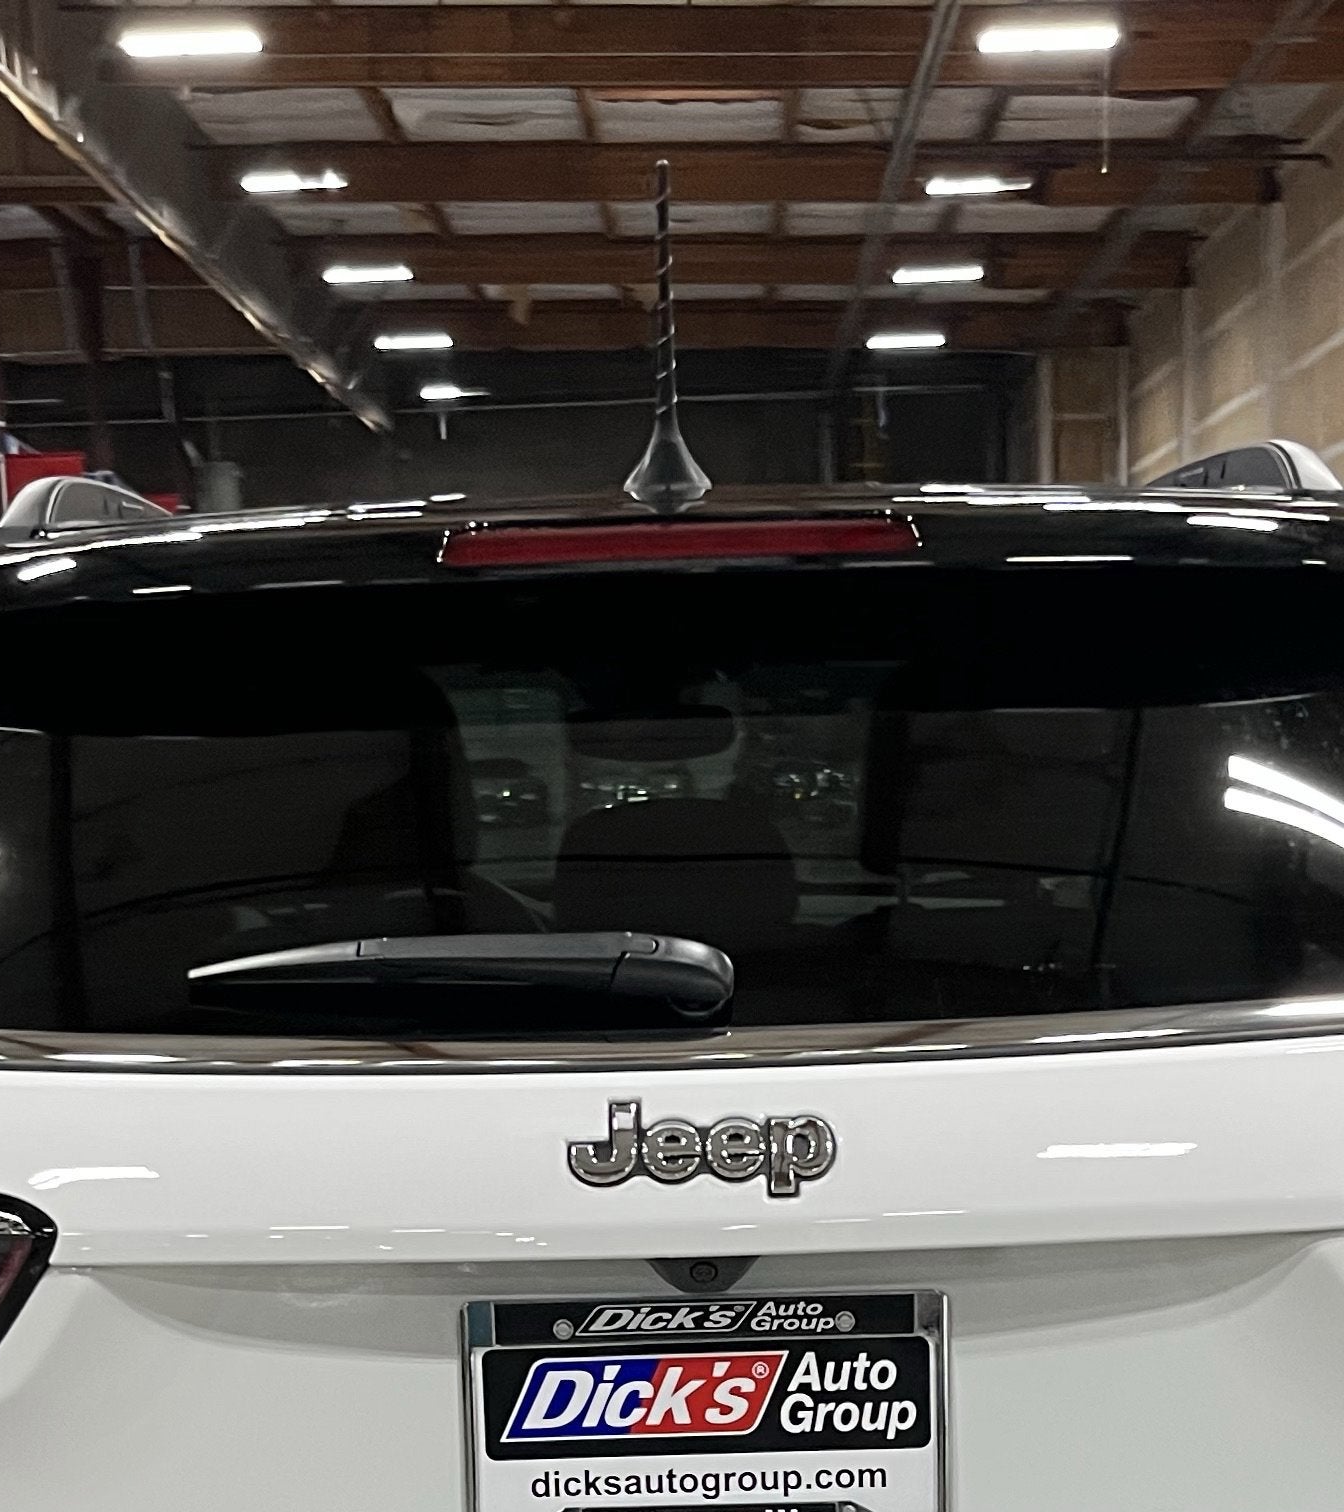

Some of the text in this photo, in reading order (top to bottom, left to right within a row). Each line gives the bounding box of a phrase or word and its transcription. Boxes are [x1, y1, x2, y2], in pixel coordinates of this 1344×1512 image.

[566, 1097, 838, 1199] Jeep
[750, 1315, 835, 1333] Group
[757, 1300, 824, 1317] Auto
[787, 1351, 898, 1393] Auto
[779, 1393, 918, 1440] Group
[531, 1465, 888, 1500] dicksautogroup.com
